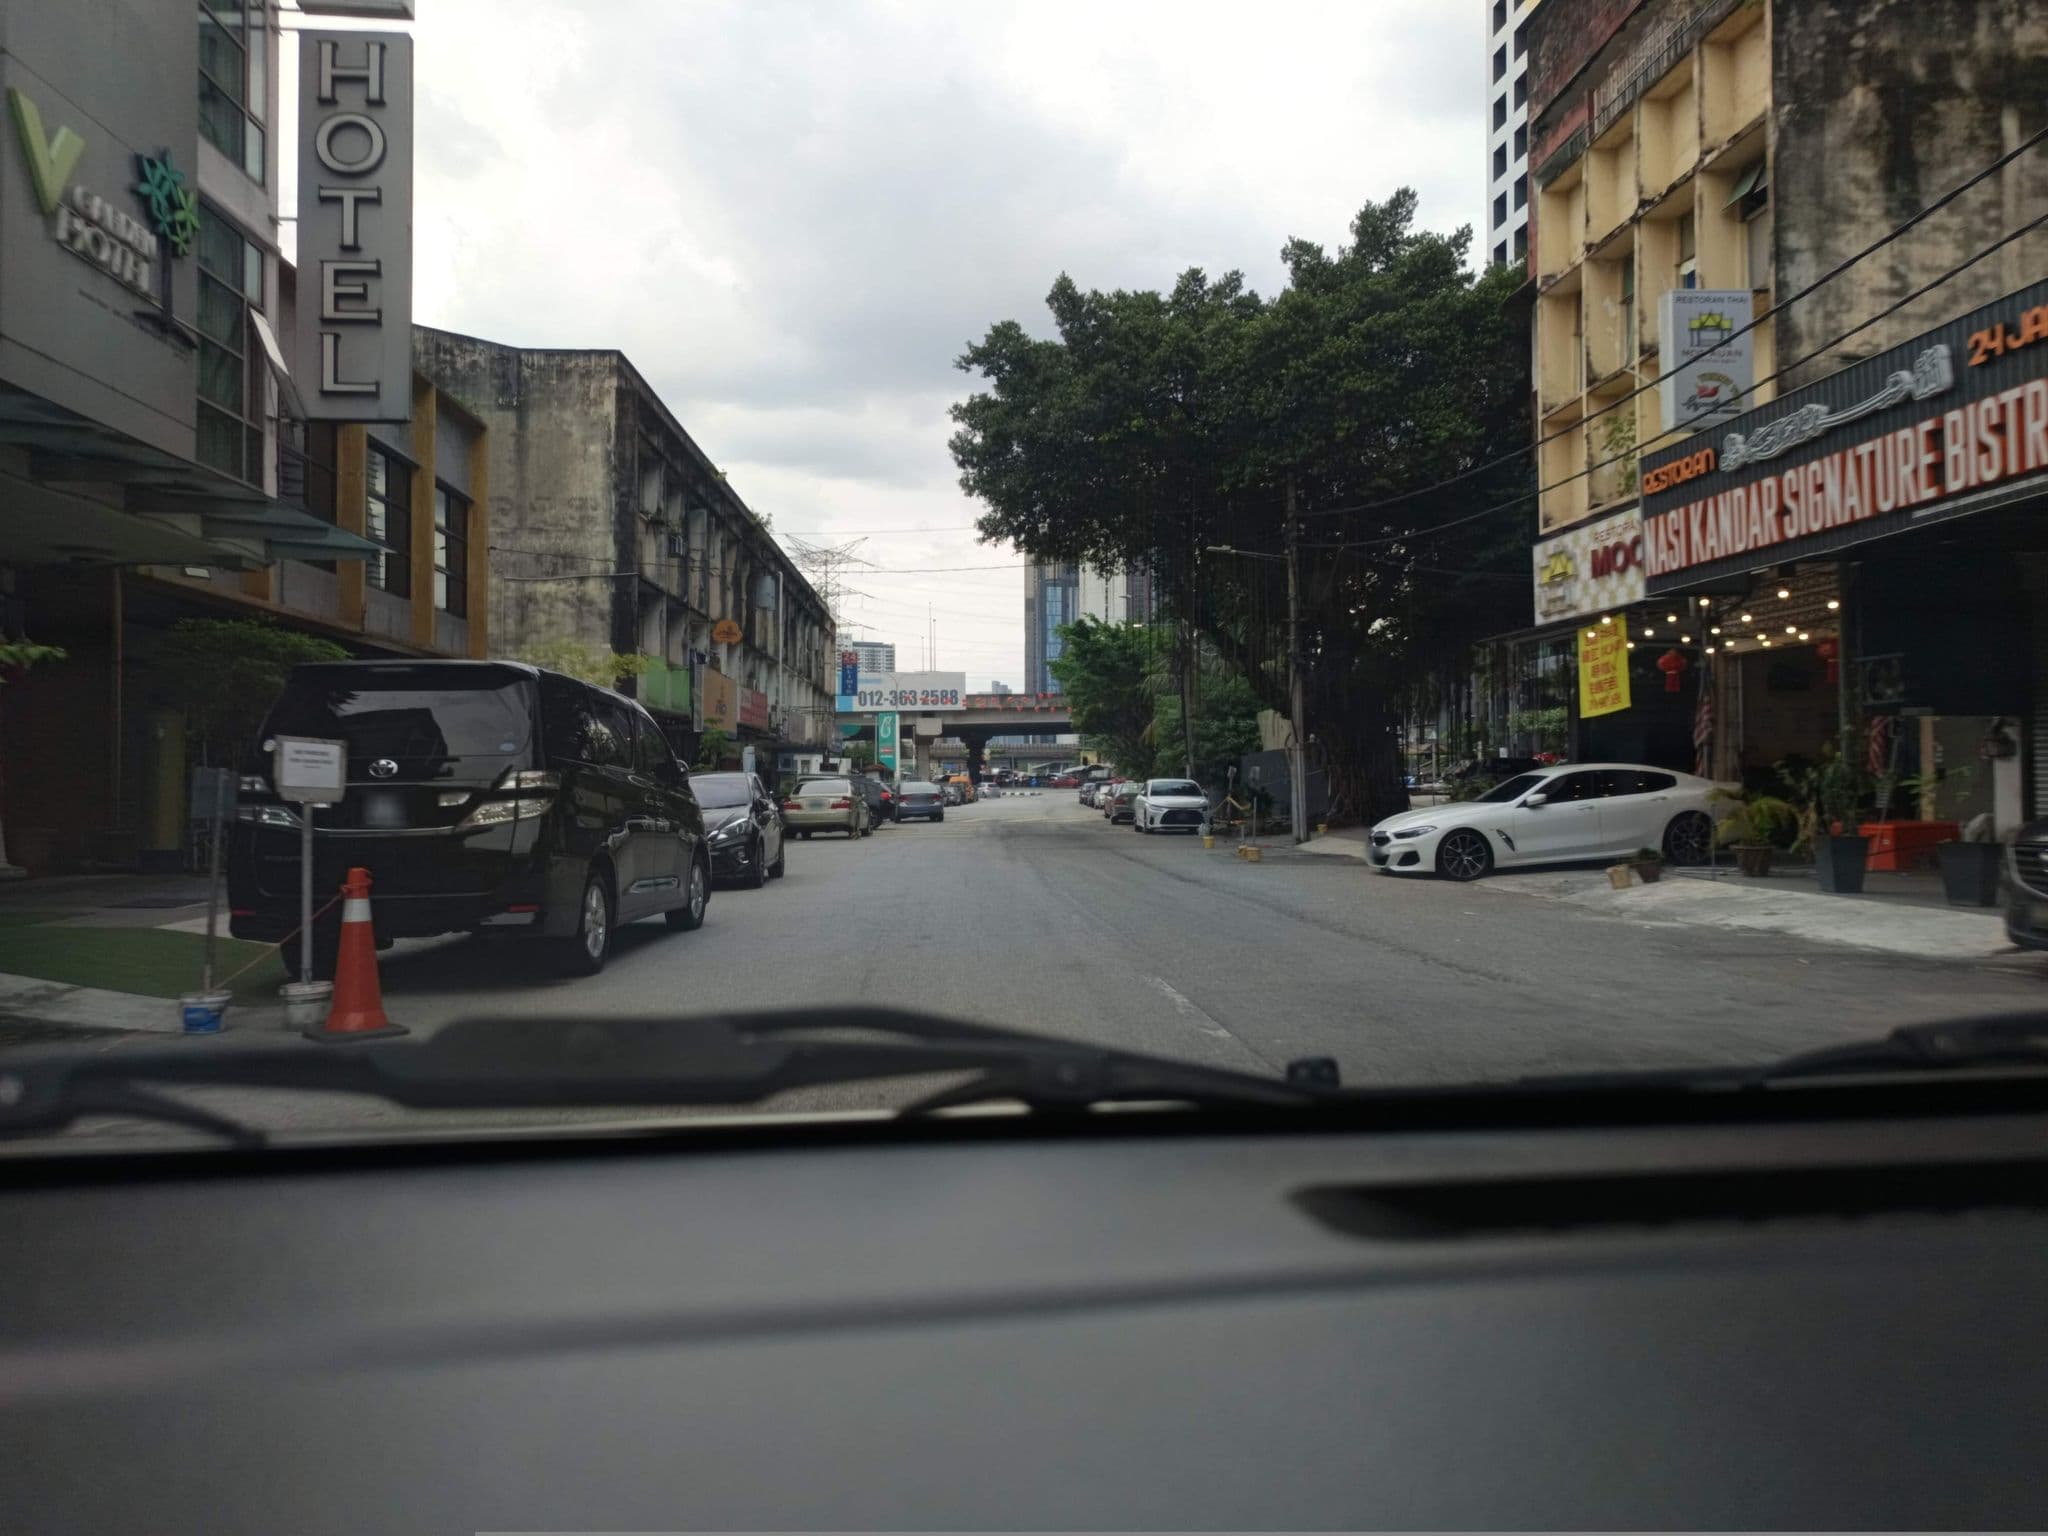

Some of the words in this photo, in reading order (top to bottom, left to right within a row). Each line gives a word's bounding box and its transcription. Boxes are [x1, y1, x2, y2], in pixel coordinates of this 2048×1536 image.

[316, 40, 386, 396] HOTEL
[1967, 321, 2005, 367] 24
[1643, 448, 1715, 496] RESTORAN
[1643, 506, 1689, 577] NASI
[1689, 475, 1779, 566] KANDAR
[1782, 418, 1941, 540] SIGNATURE
[858, 690, 917, 707] 012-363
[921, 689, 959, 706] 2588
